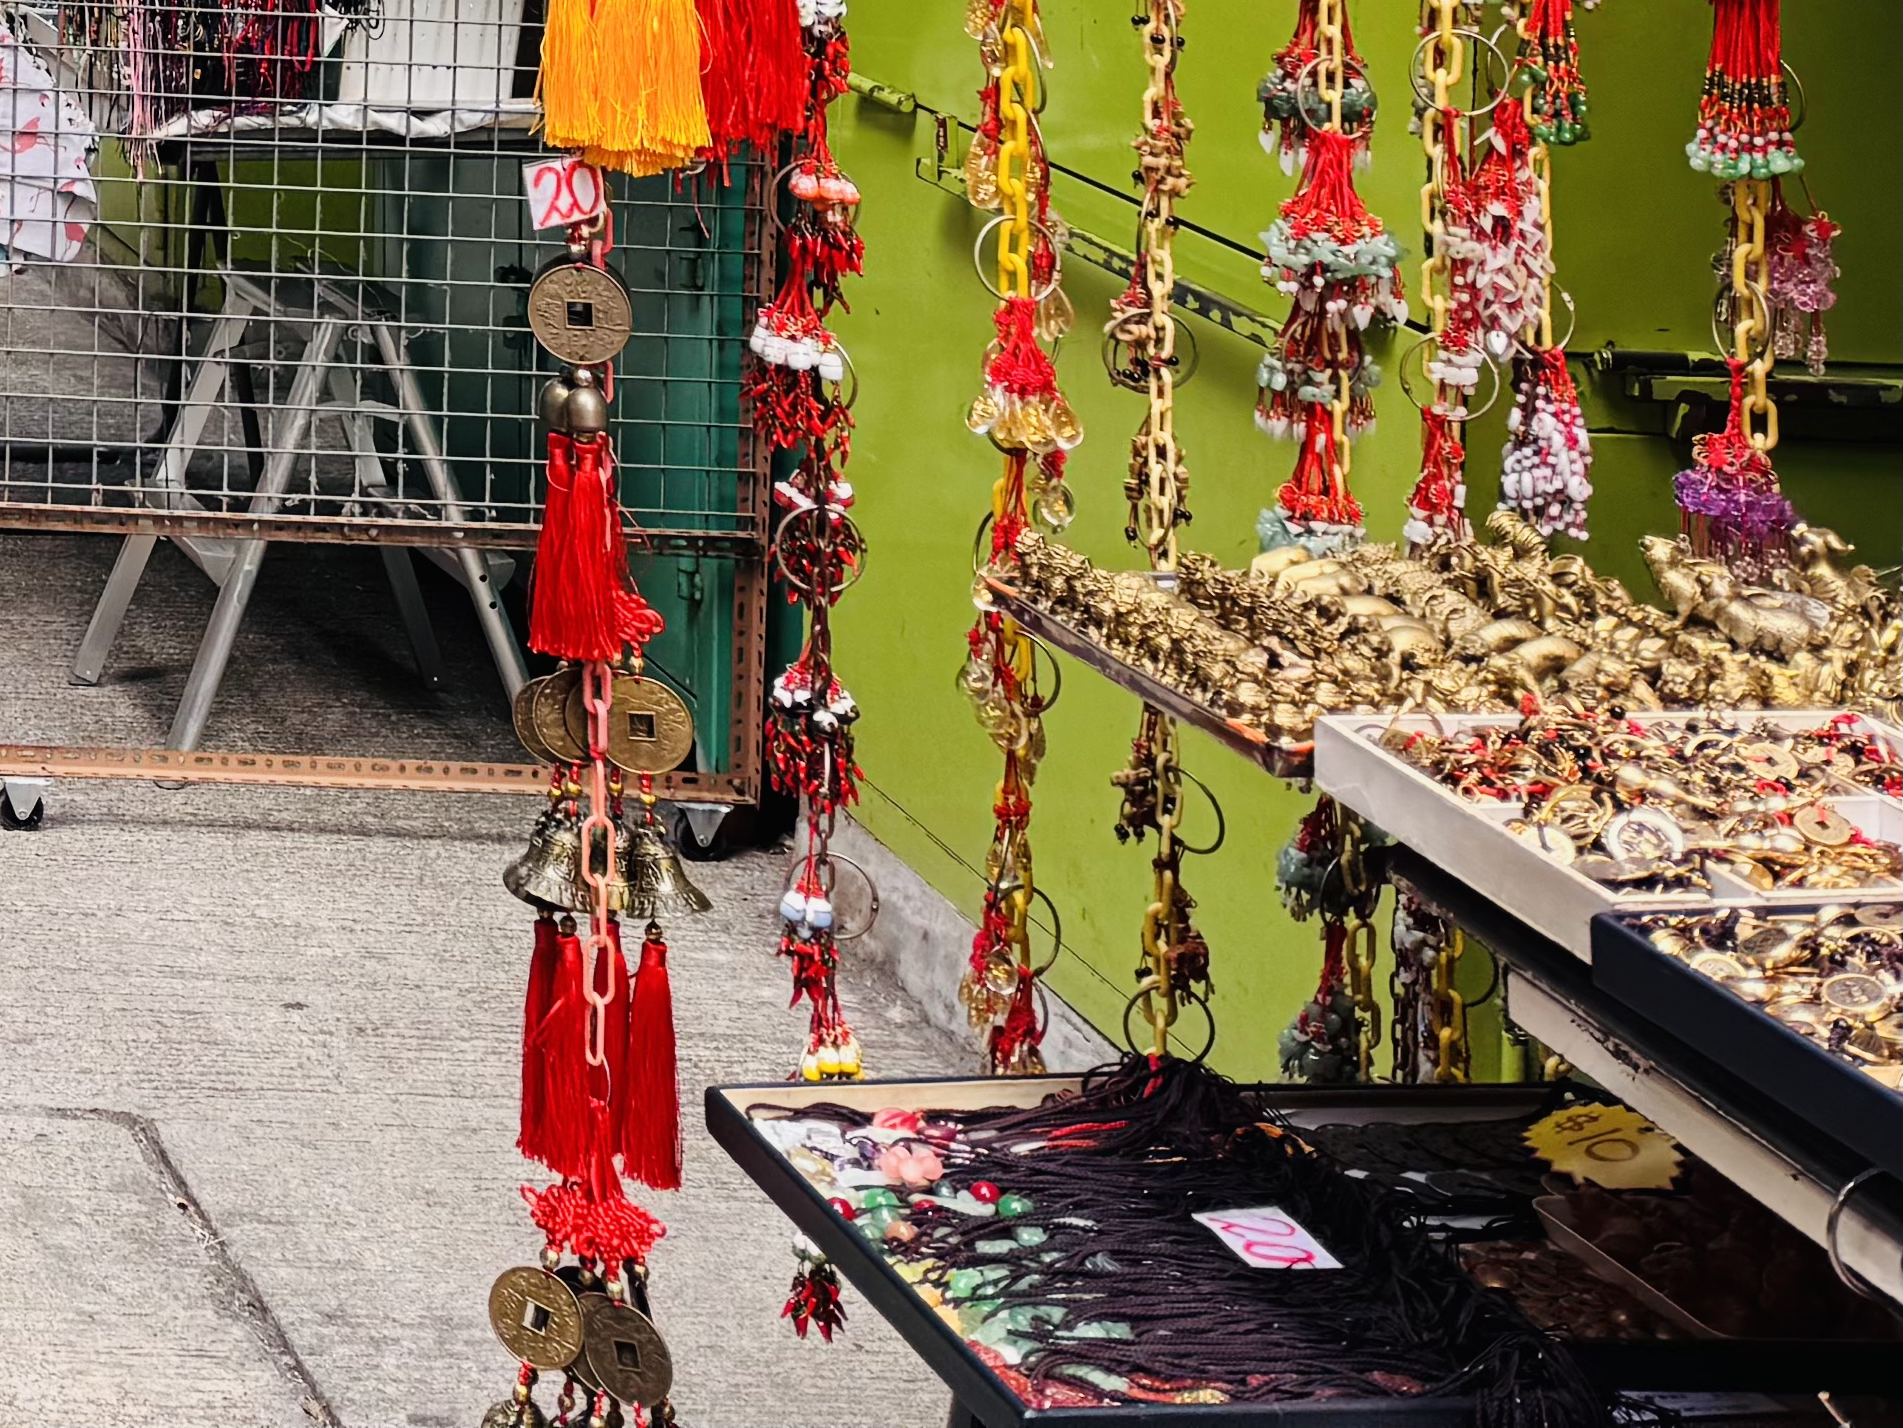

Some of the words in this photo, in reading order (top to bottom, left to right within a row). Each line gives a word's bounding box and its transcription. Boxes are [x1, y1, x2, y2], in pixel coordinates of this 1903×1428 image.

[533, 160, 601, 222] 20
[1554, 1110, 1641, 1163] $10
[1212, 1214, 1317, 1268] 20
